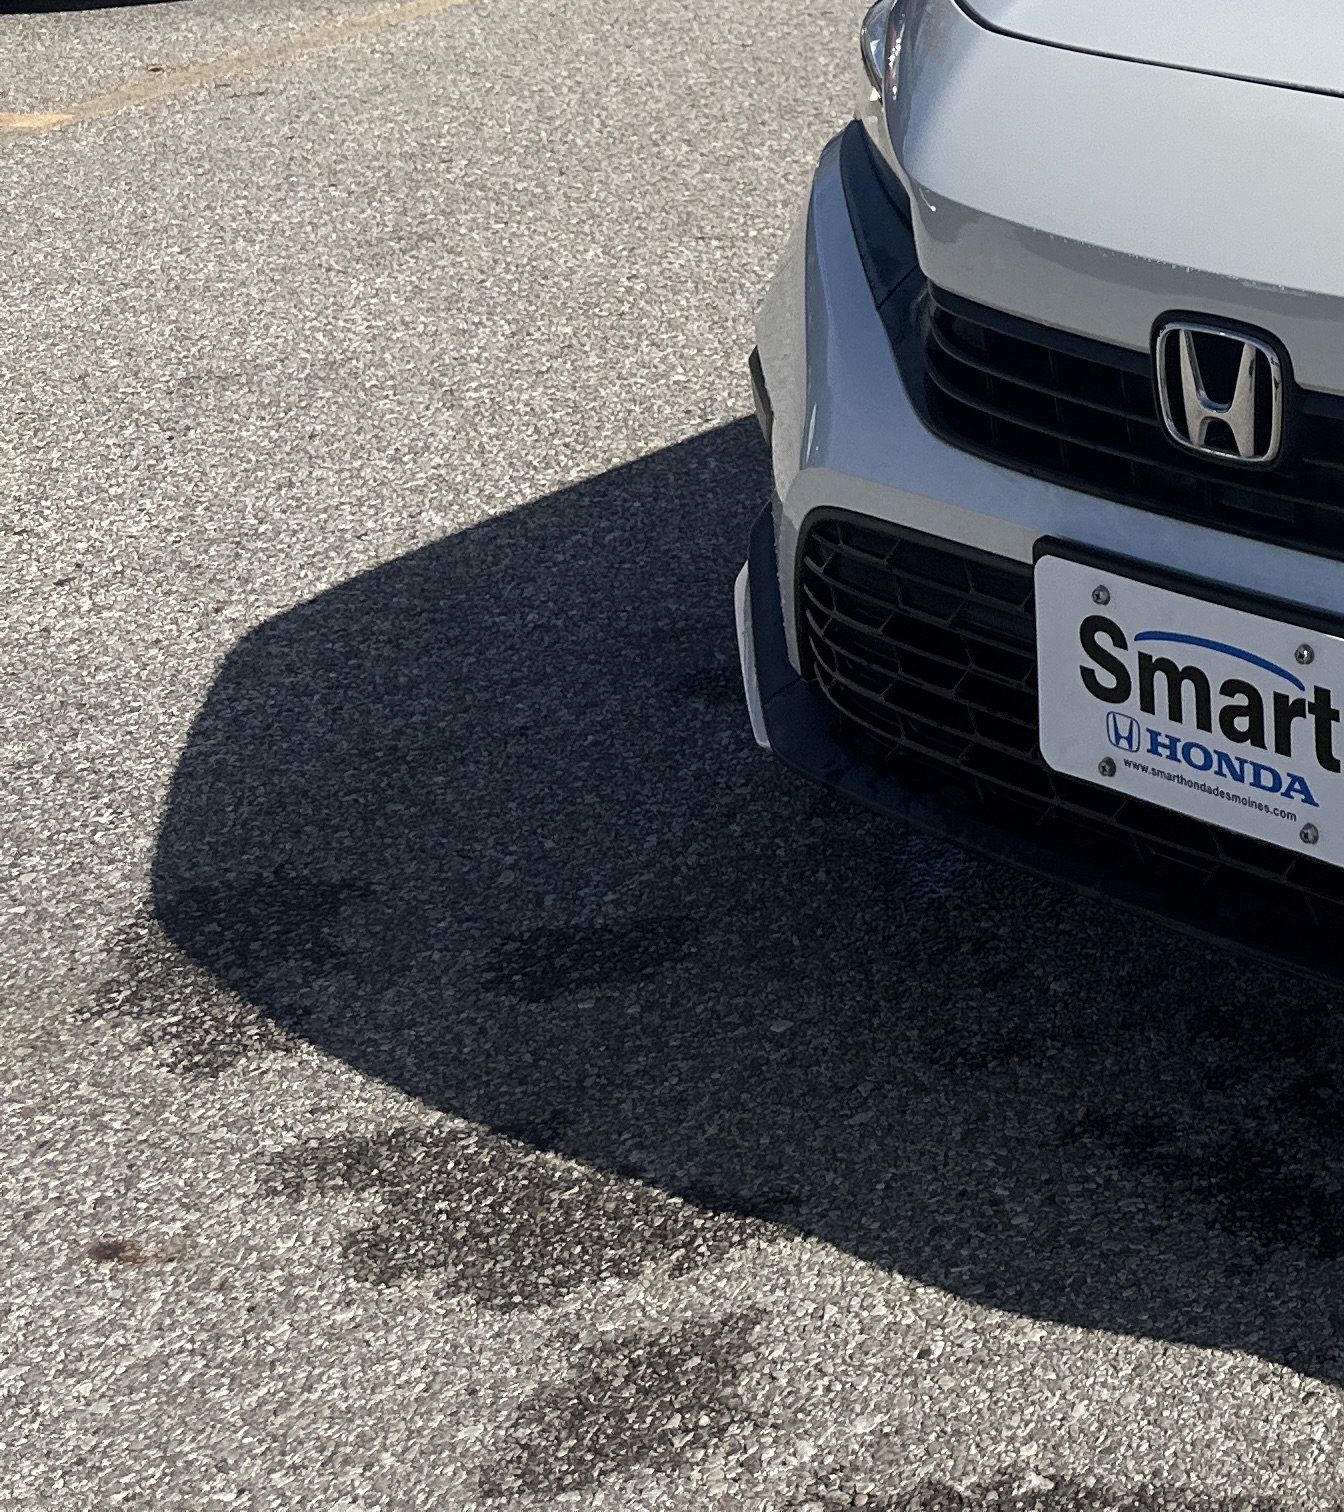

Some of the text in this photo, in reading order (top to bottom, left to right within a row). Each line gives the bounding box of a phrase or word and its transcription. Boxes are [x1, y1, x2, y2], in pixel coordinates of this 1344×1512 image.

[1080, 614, 1341, 773] Smart
[1123, 757, 1297, 822] www.smarthondadesmoines.com
[1146, 727, 1320, 807] HONDA
